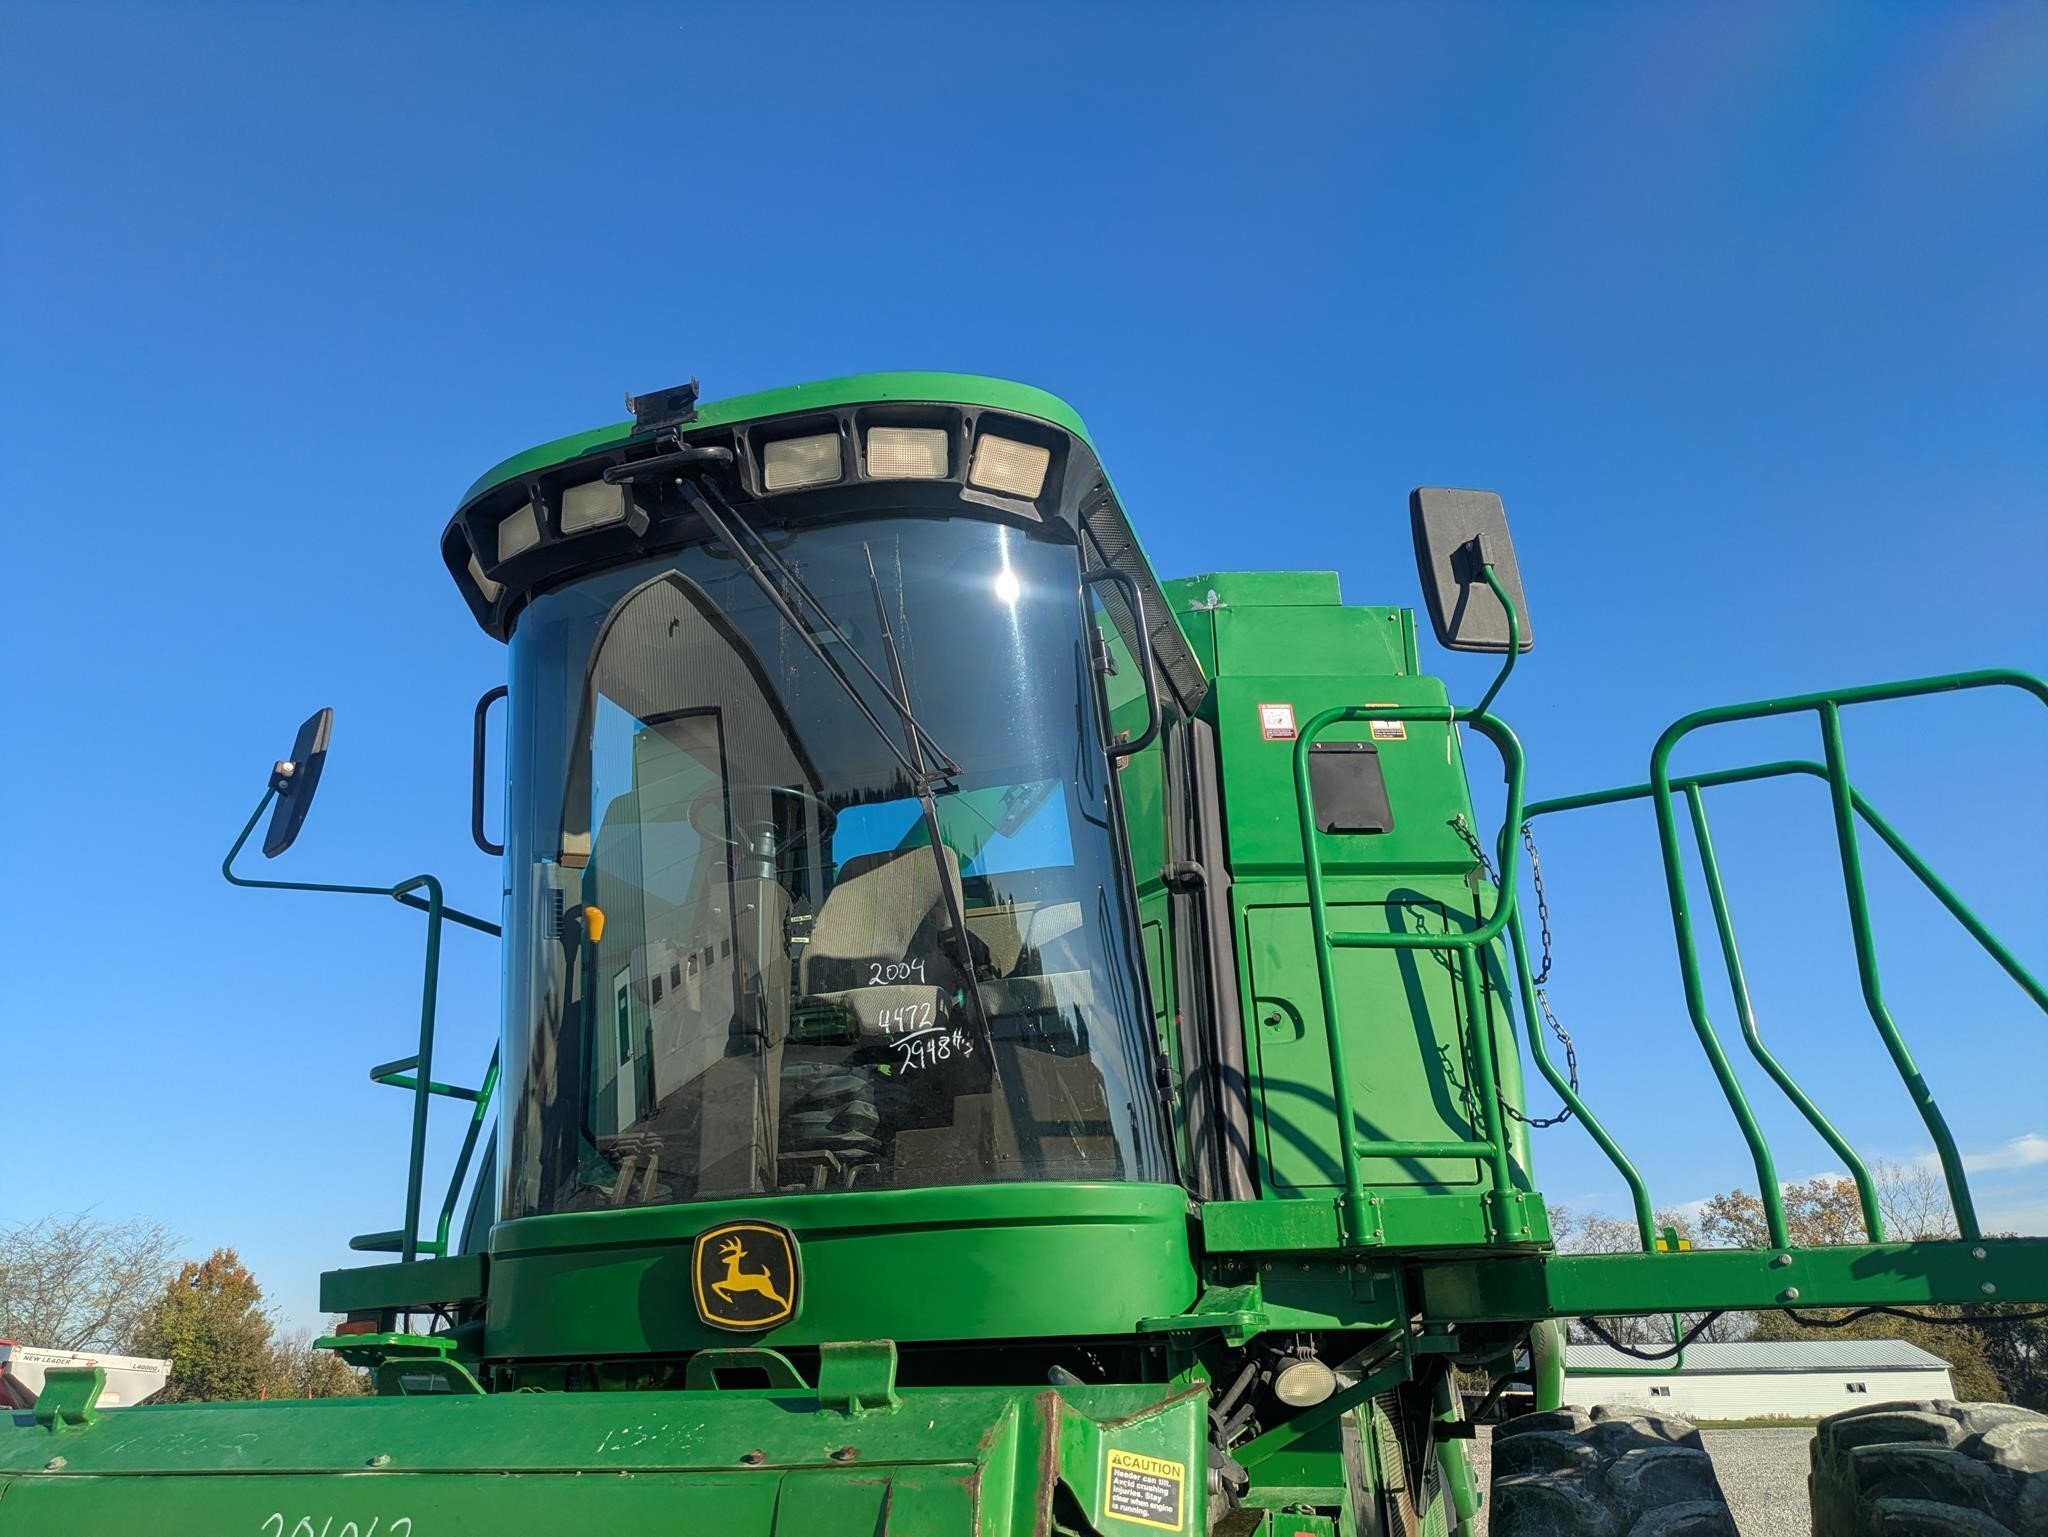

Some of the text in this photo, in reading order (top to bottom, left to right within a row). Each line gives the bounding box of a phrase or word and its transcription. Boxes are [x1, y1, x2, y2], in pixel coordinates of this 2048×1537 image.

[869, 958, 925, 985] 2004
[879, 1003, 933, 1034] 4472
[897, 1036, 951, 1075] 2948
[42, 1357, 71, 1365] LEADER
[1123, 1456, 1180, 1477] CAUTION
[1113, 1468, 1171, 1487] Header can tilt.
[1113, 1477, 1169, 1497] Avoid crushing
[1112, 1494, 1173, 1512] clear when engine
[1113, 1486, 1162, 1504] injuries. Stay
[1120, 1505, 1150, 1517] running.
